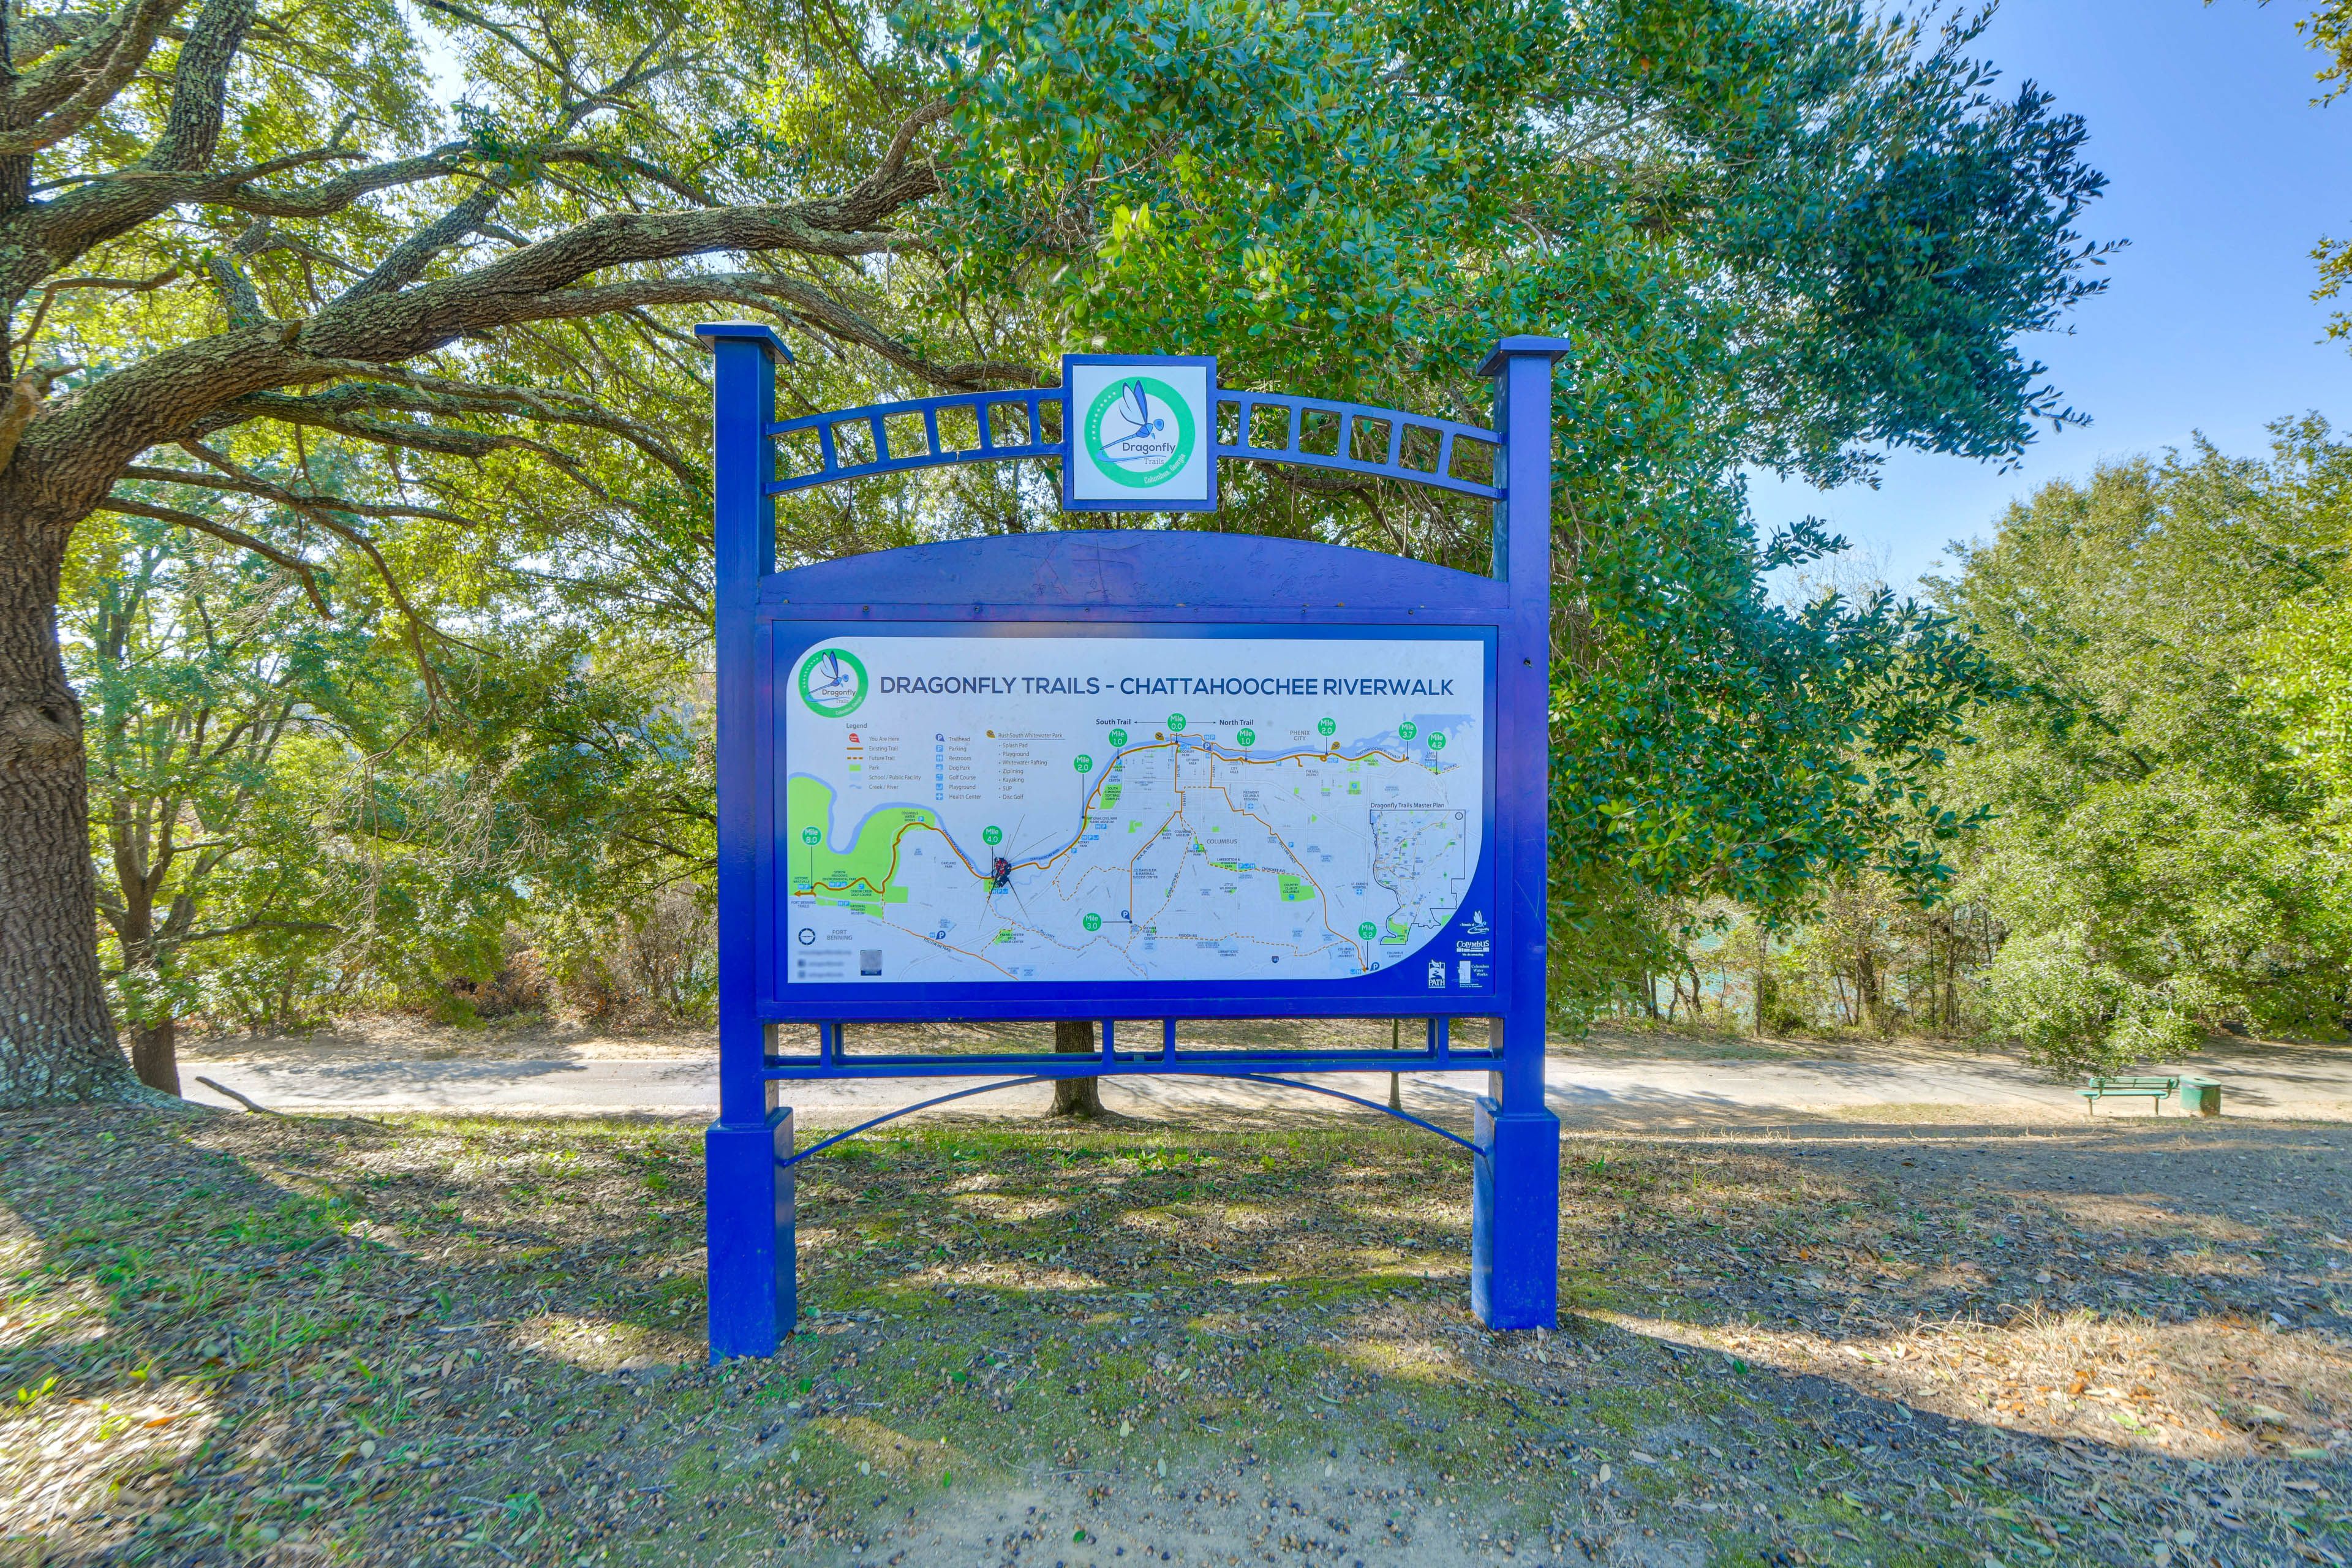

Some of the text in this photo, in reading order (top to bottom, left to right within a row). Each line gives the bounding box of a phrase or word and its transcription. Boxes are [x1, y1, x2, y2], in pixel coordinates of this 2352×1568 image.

[1123, 443, 1176, 454] Dragonfly
[880, 677, 1017, 693] DRAGONFLY
[1022, 677, 1099, 694] TRAILS
[1120, 678, 1317, 695] CHATTAHOOCHEE
[1324, 679, 1455, 696] RIVERWALK
